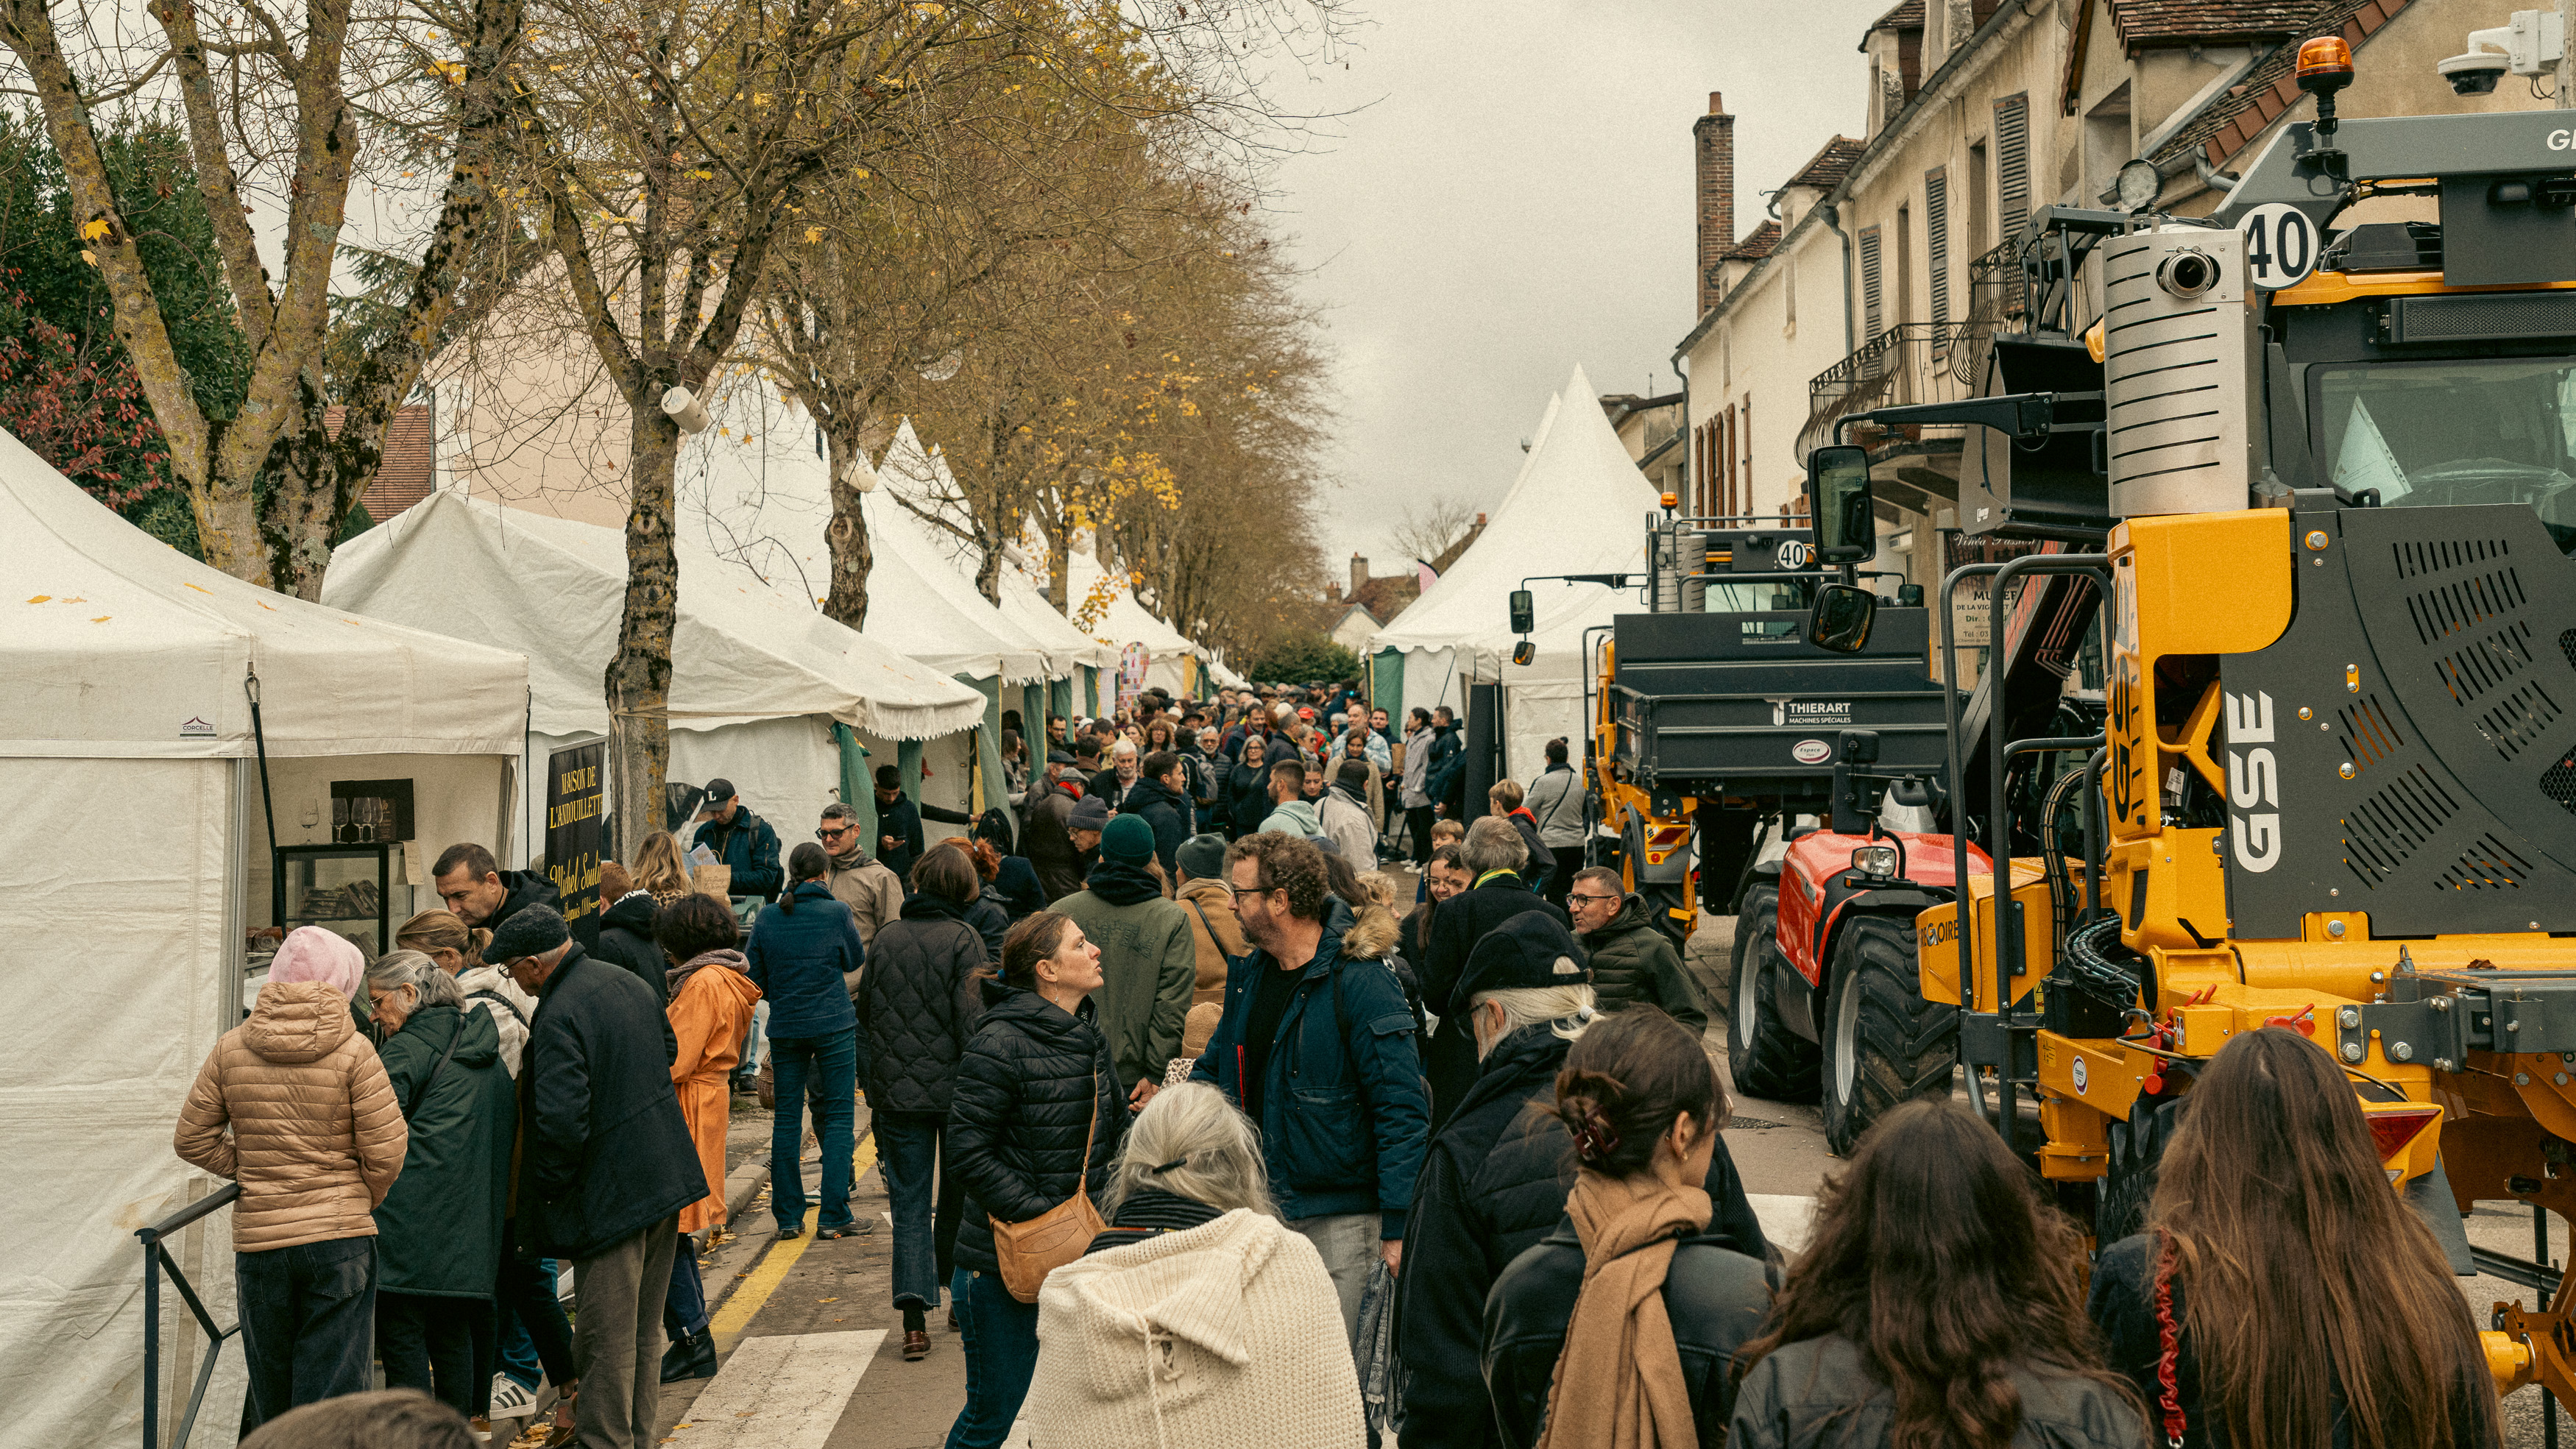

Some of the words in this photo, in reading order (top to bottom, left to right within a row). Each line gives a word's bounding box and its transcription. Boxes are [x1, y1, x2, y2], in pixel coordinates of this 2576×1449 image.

[2247, 211, 2309, 278] 40
[1780, 544, 1803, 566] 40
[1788, 702, 1851, 714] THIERART
[561, 768, 586, 796] MAISON
[587, 765, 596, 787] DE
[2225, 690, 2282, 873] GSE
[708, 790, 717, 801] L
[550, 856, 580, 899] Michel
[581, 895, 591, 916] 1886
